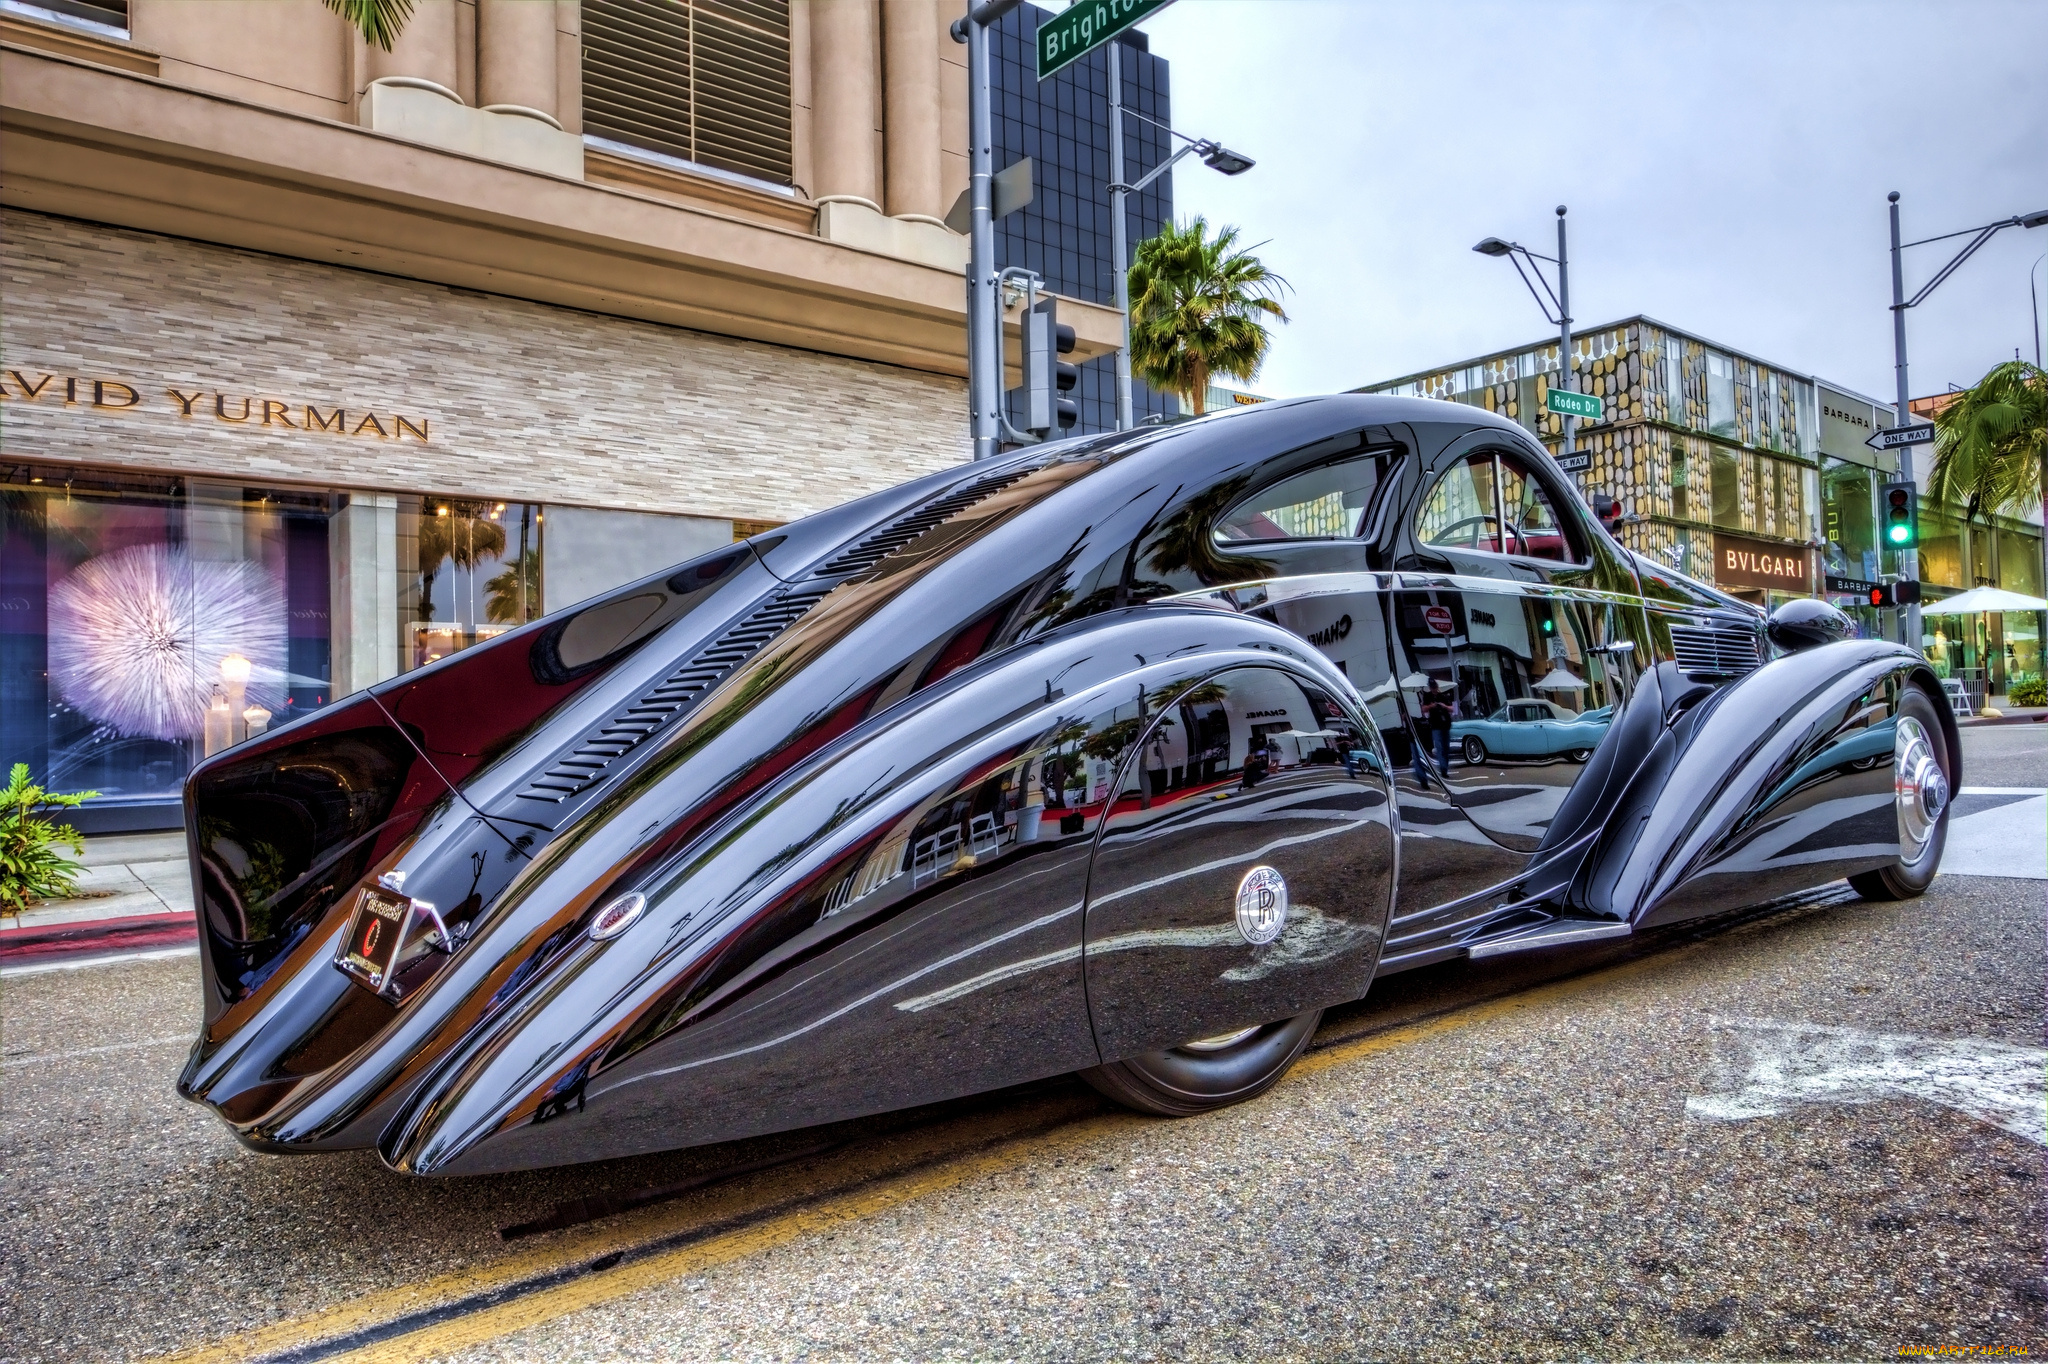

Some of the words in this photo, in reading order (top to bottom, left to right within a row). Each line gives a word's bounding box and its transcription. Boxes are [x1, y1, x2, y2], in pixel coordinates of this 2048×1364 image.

[1046, 0, 1142, 61] Brighto
[0, 370, 140, 408] VID
[167, 387, 430, 443] YURMAN
[1554, 394, 1581, 411] Rodeo
[1585, 400, 1595, 413] Dr
[1823, 405, 1870, 430] BARBARA
[1885, 433, 1905, 444] ONE
[1907, 429, 1928, 441] WAY
[1558, 459, 1568, 469] NE
[1569, 456, 1586, 467] WAY
[1726, 549, 1803, 578] BVLGARI
